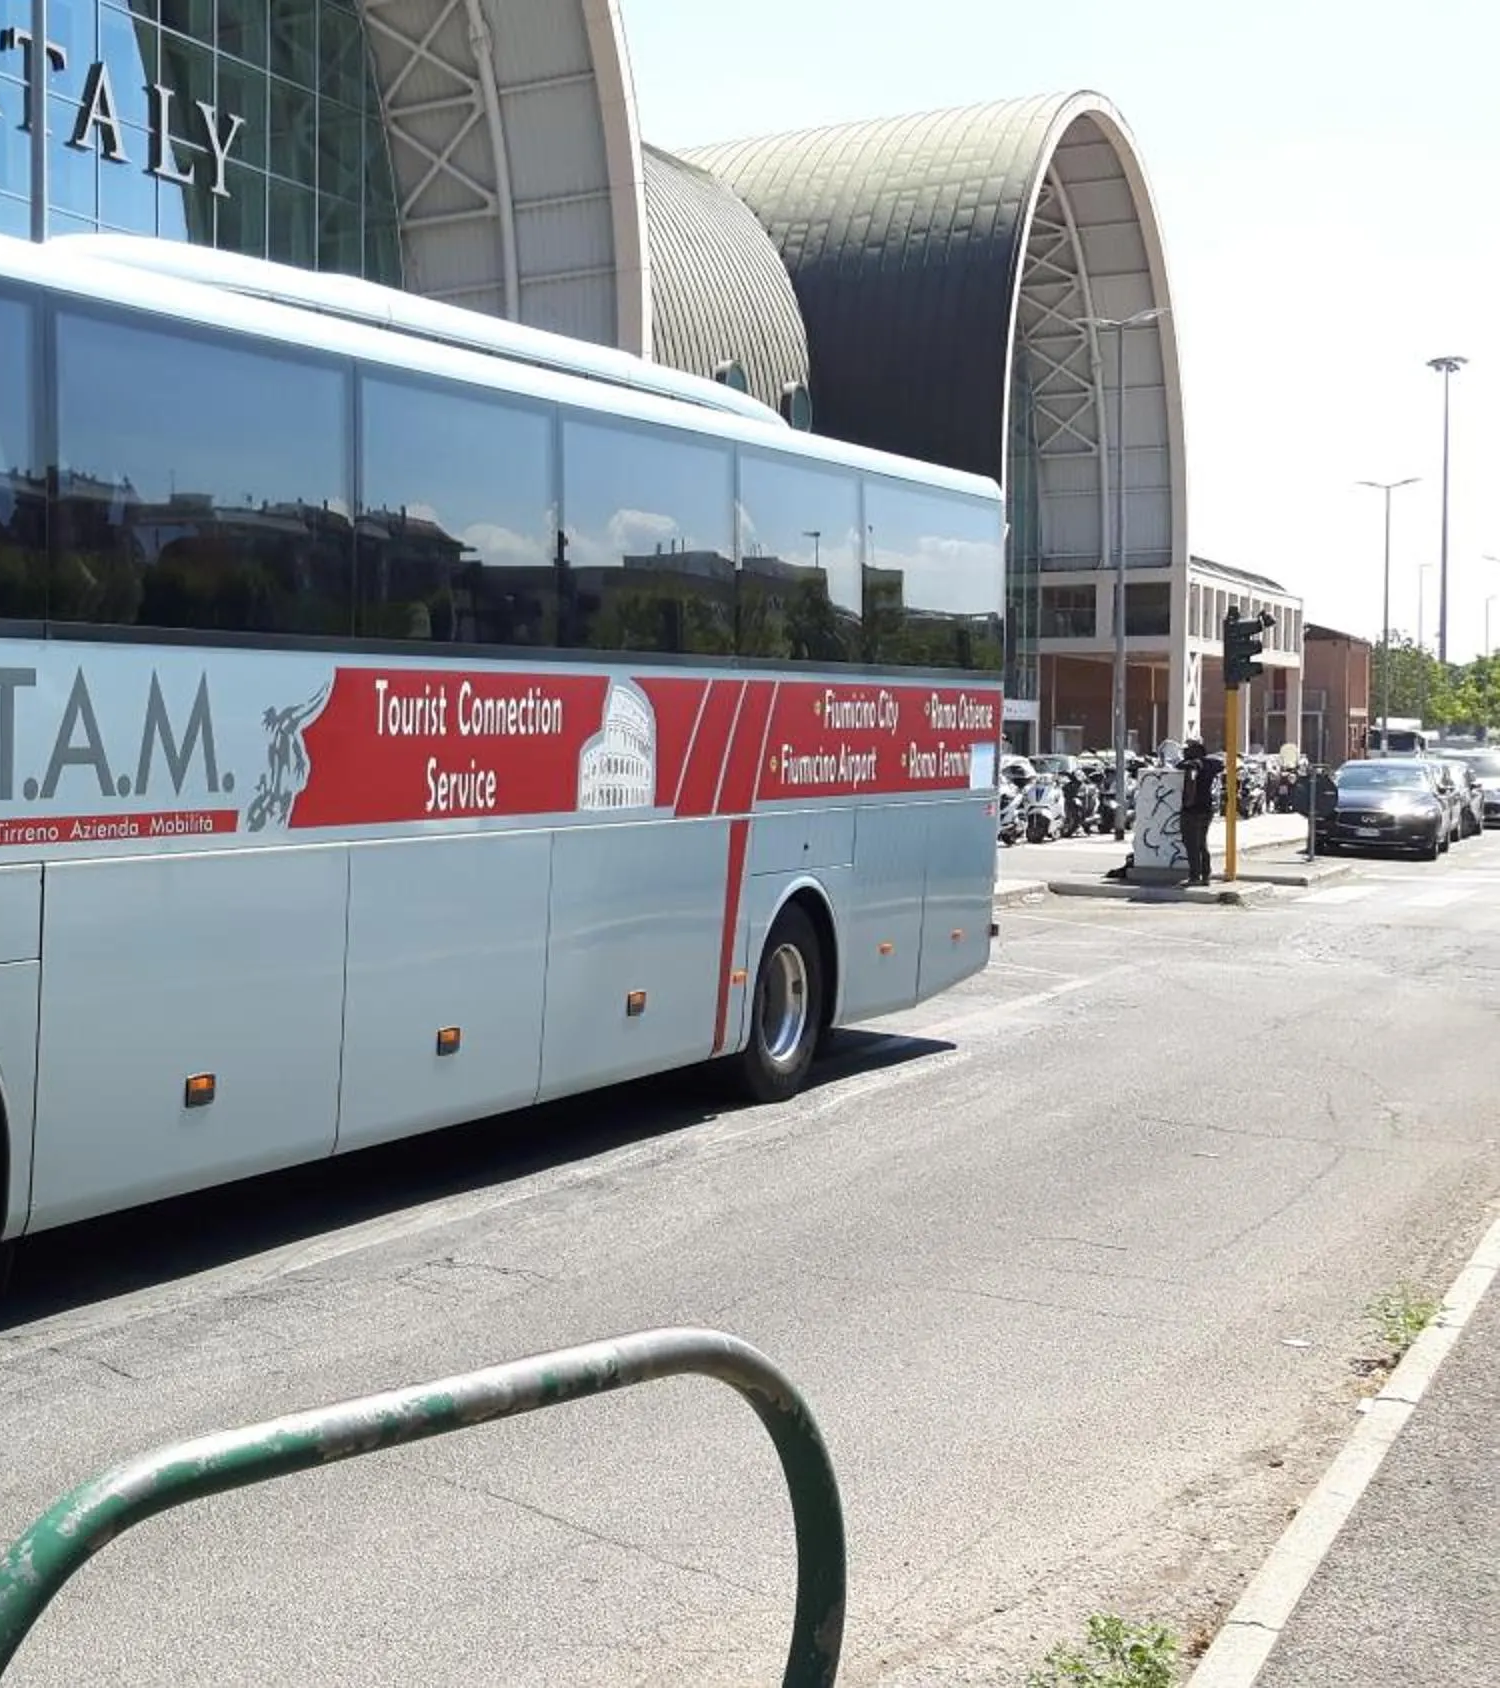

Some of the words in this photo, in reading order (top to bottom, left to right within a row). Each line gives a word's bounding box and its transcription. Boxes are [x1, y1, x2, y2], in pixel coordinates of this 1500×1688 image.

[375, 679, 447, 735] Tourist
[458, 680, 562, 735] Connection
[824, 689, 876, 729] Fiumicino
[879, 690, 899, 735] City
[931, 692, 957, 730] Roma
[780, 744, 835, 785] Fiumicino
[838, 743, 877, 790] Airport
[909, 741, 937, 779] Roma
[426, 757, 497, 812] Service
[70, 820, 139, 839] Azienda
